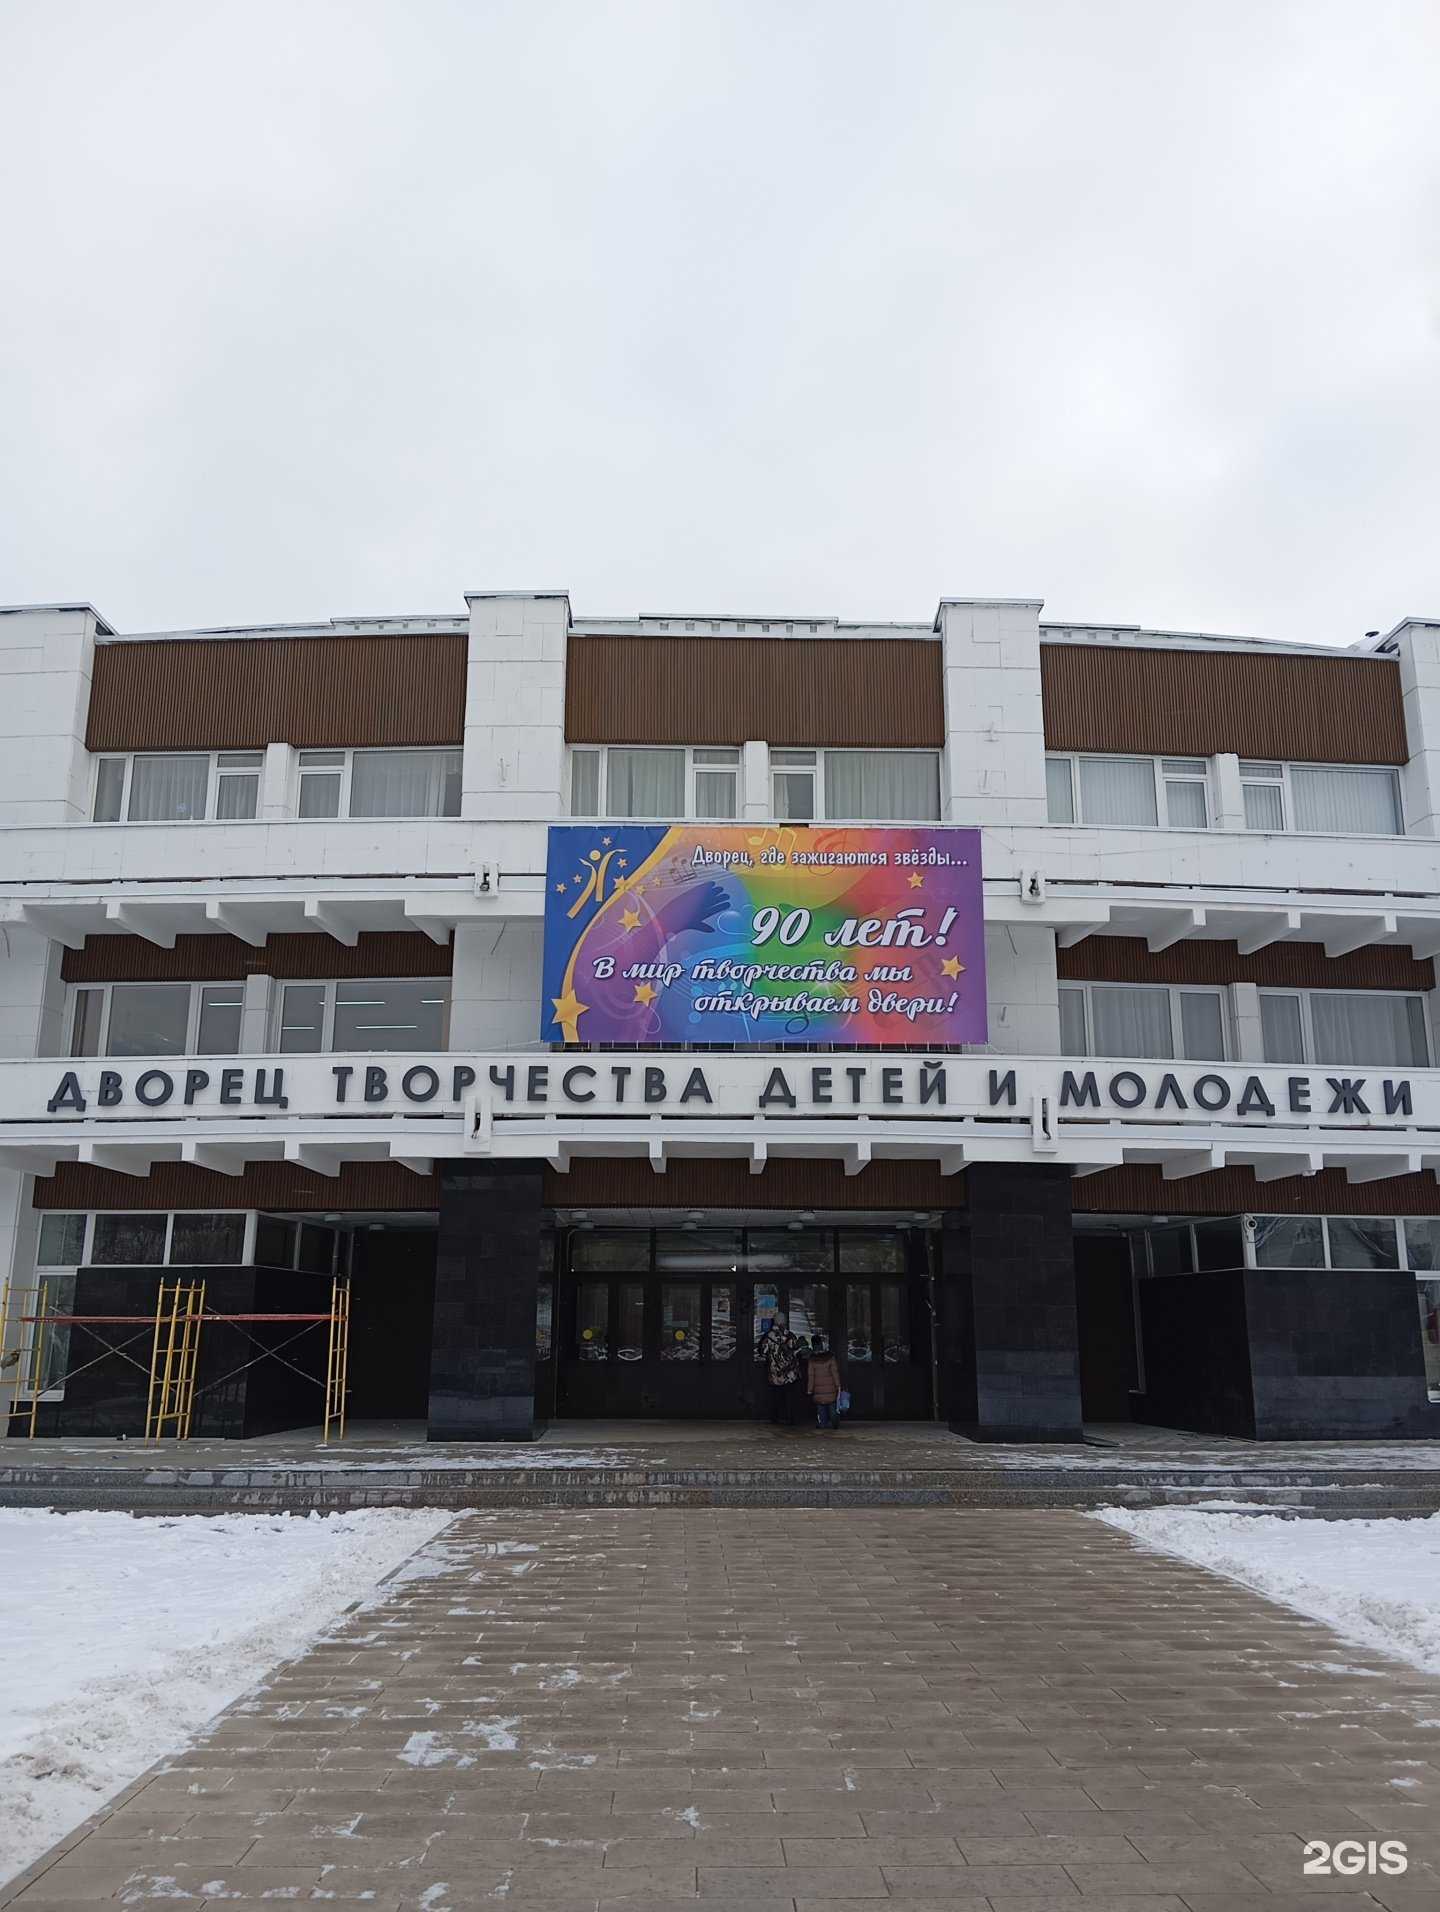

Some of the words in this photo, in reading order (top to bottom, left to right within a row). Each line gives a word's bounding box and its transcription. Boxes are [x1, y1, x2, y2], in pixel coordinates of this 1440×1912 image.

[691, 845, 754, 868] Дворец,
[760, 847, 786, 866] где
[791, 851, 888, 866] зажигаются
[894, 847, 969, 867] звёзды...
[751, 906, 811, 946] 90
[824, 906, 960, 948] лет!
[592, 956, 615, 980] В
[622, 961, 685, 987] мир
[691, 958, 857, 987] творчества
[863, 962, 913, 982] мы
[694, 990, 859, 1022] открываем
[867, 989, 959, 1021] двери!
[47, 1068, 289, 1112] ДВОРЕЦ
[332, 1064, 713, 1103] ТВОРЧЕСТВА
[758, 1060, 947, 1108] ДЕТЕЙ
[988, 1069, 1017, 1106] И
[1059, 1070, 1413, 1116] МОЛОДЕЖИ
